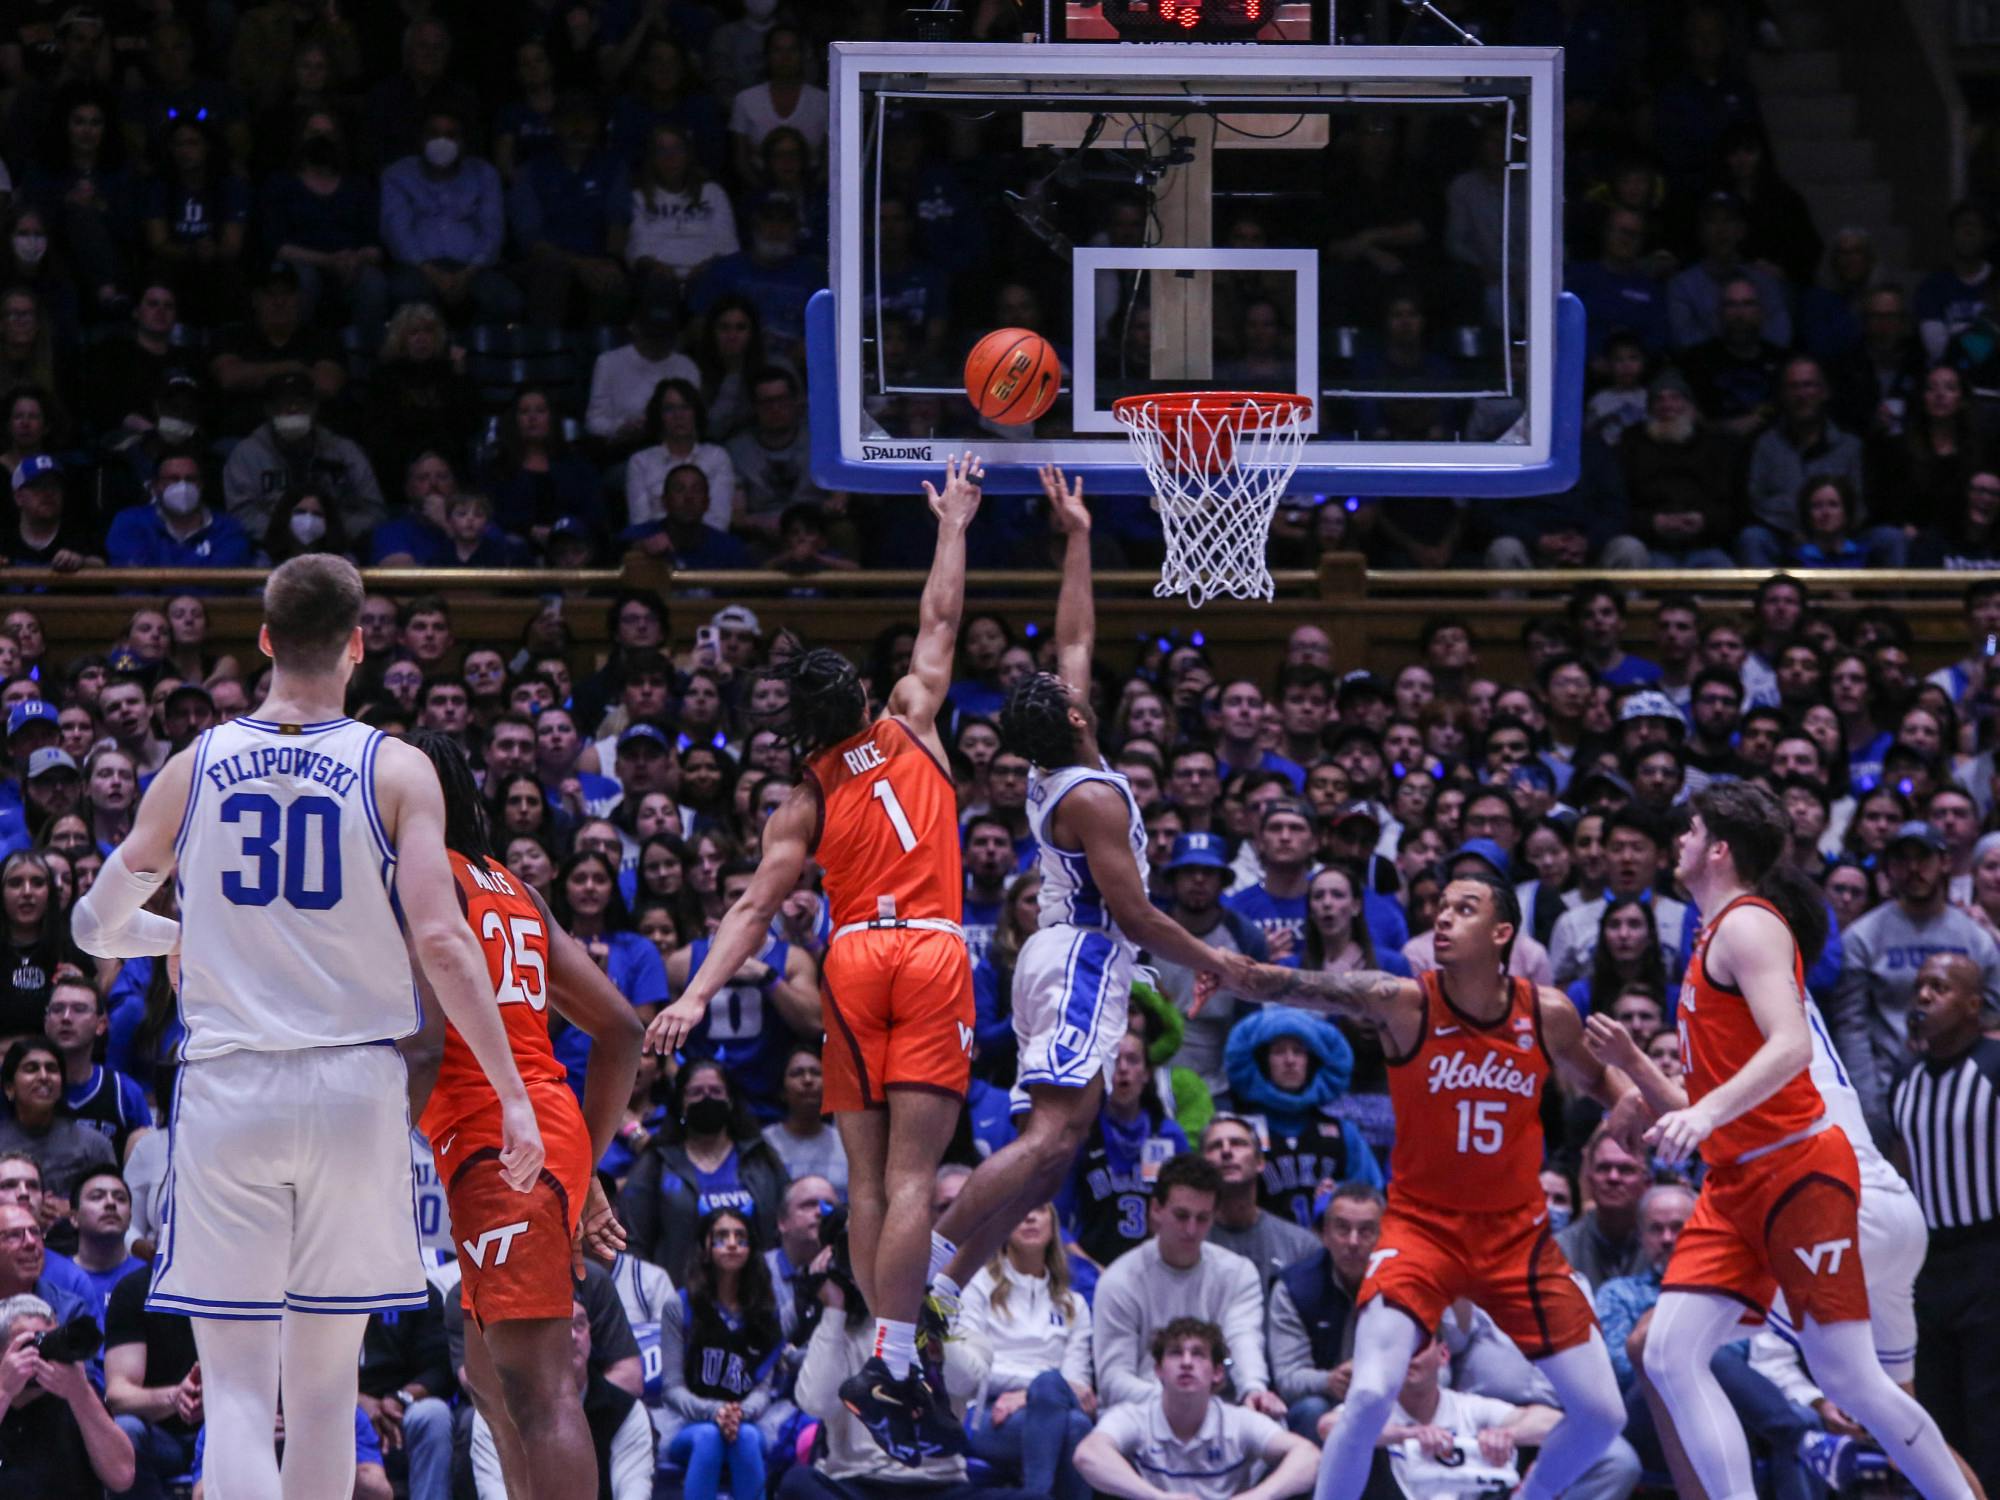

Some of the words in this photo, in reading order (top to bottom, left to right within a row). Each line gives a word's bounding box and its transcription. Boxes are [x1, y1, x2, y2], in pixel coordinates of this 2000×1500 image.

[863, 445, 932, 461] SPALDING
[206, 747, 359, 798] FILIPOWSKI
[843, 741, 887, 776] RICE
[872, 778, 918, 854] 1
[220, 793, 342, 911] 30
[482, 910, 546, 1012] 25
[1428, 1050, 1536, 1098] Hokies
[1456, 1099, 1507, 1154] 15
[1117, 1193, 1148, 1238] 3
[462, 1221, 529, 1269] VT
[1793, 1238, 1852, 1275] VT
